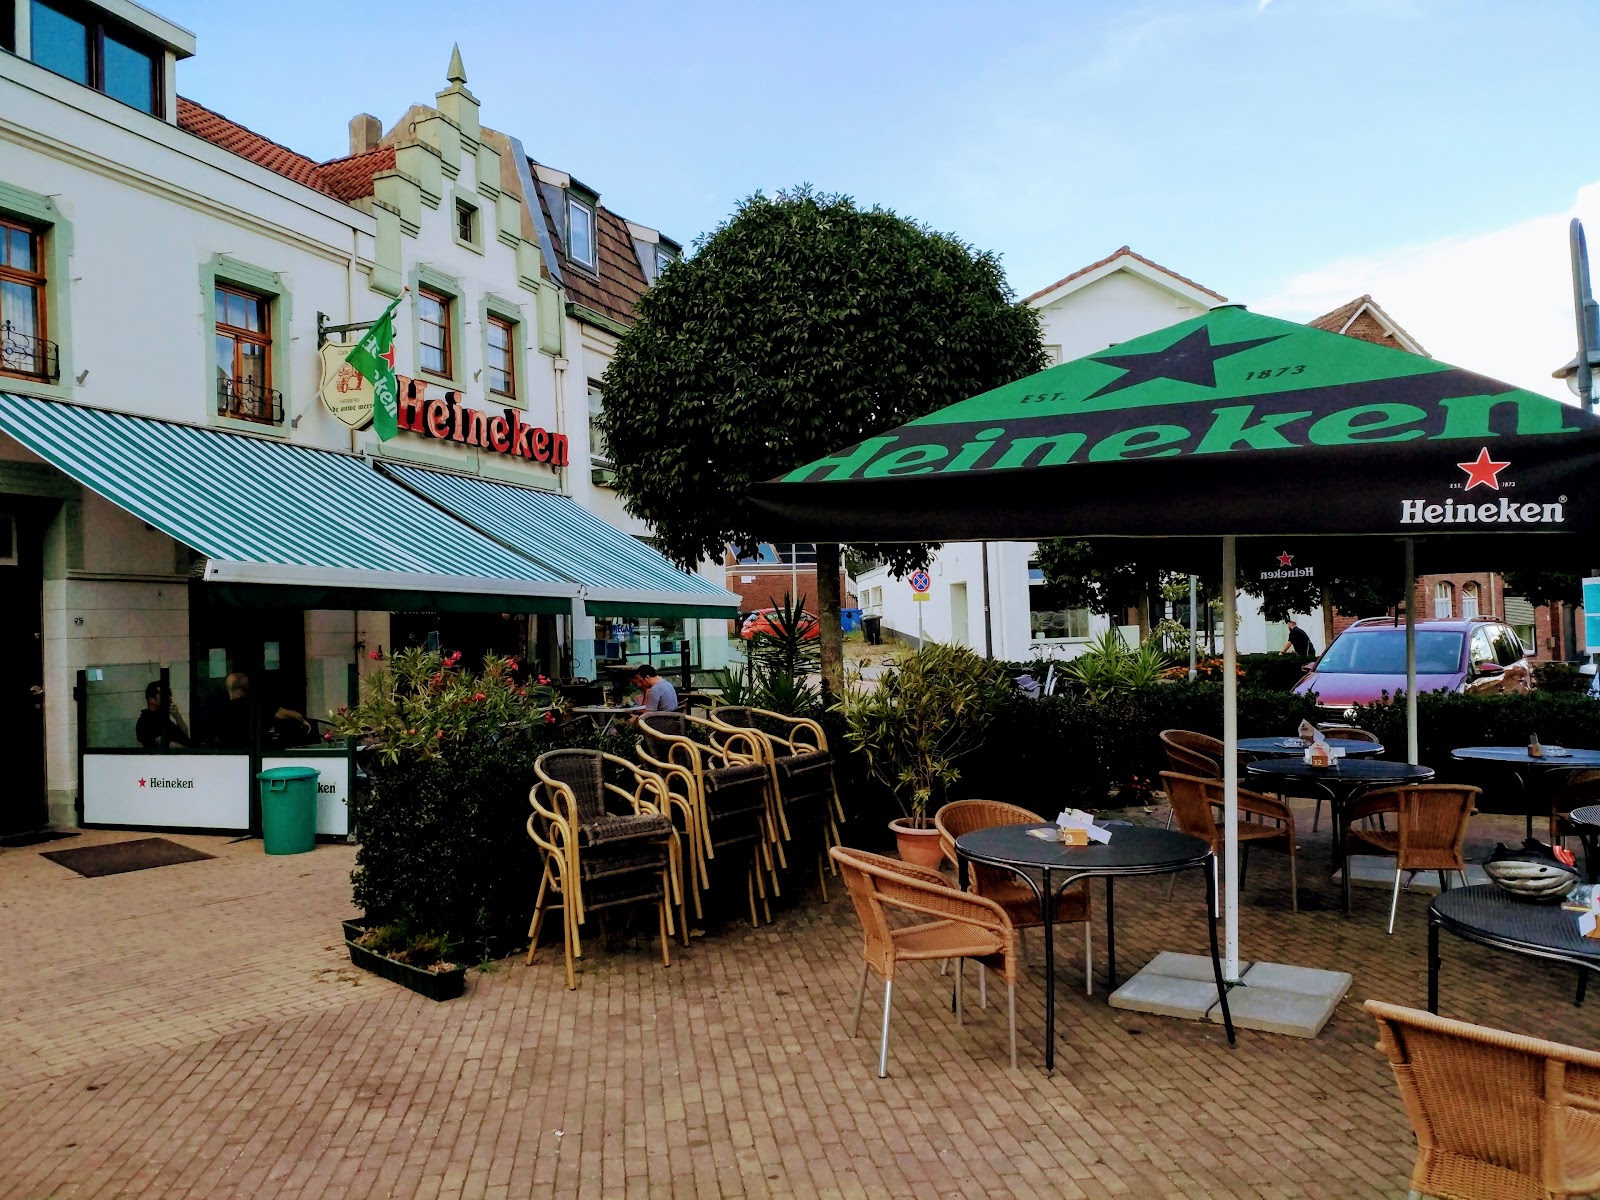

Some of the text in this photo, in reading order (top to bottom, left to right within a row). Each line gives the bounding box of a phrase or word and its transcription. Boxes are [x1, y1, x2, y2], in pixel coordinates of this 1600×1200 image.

[1020, 364, 1307, 404] EST. 1873
[397, 374, 569, 467] Heineken
[779, 389, 1582, 483] Heineken
[1400, 497, 1565, 524] Heineken
[150, 777, 194, 789] Heineken
[317, 782, 336, 794] ken
